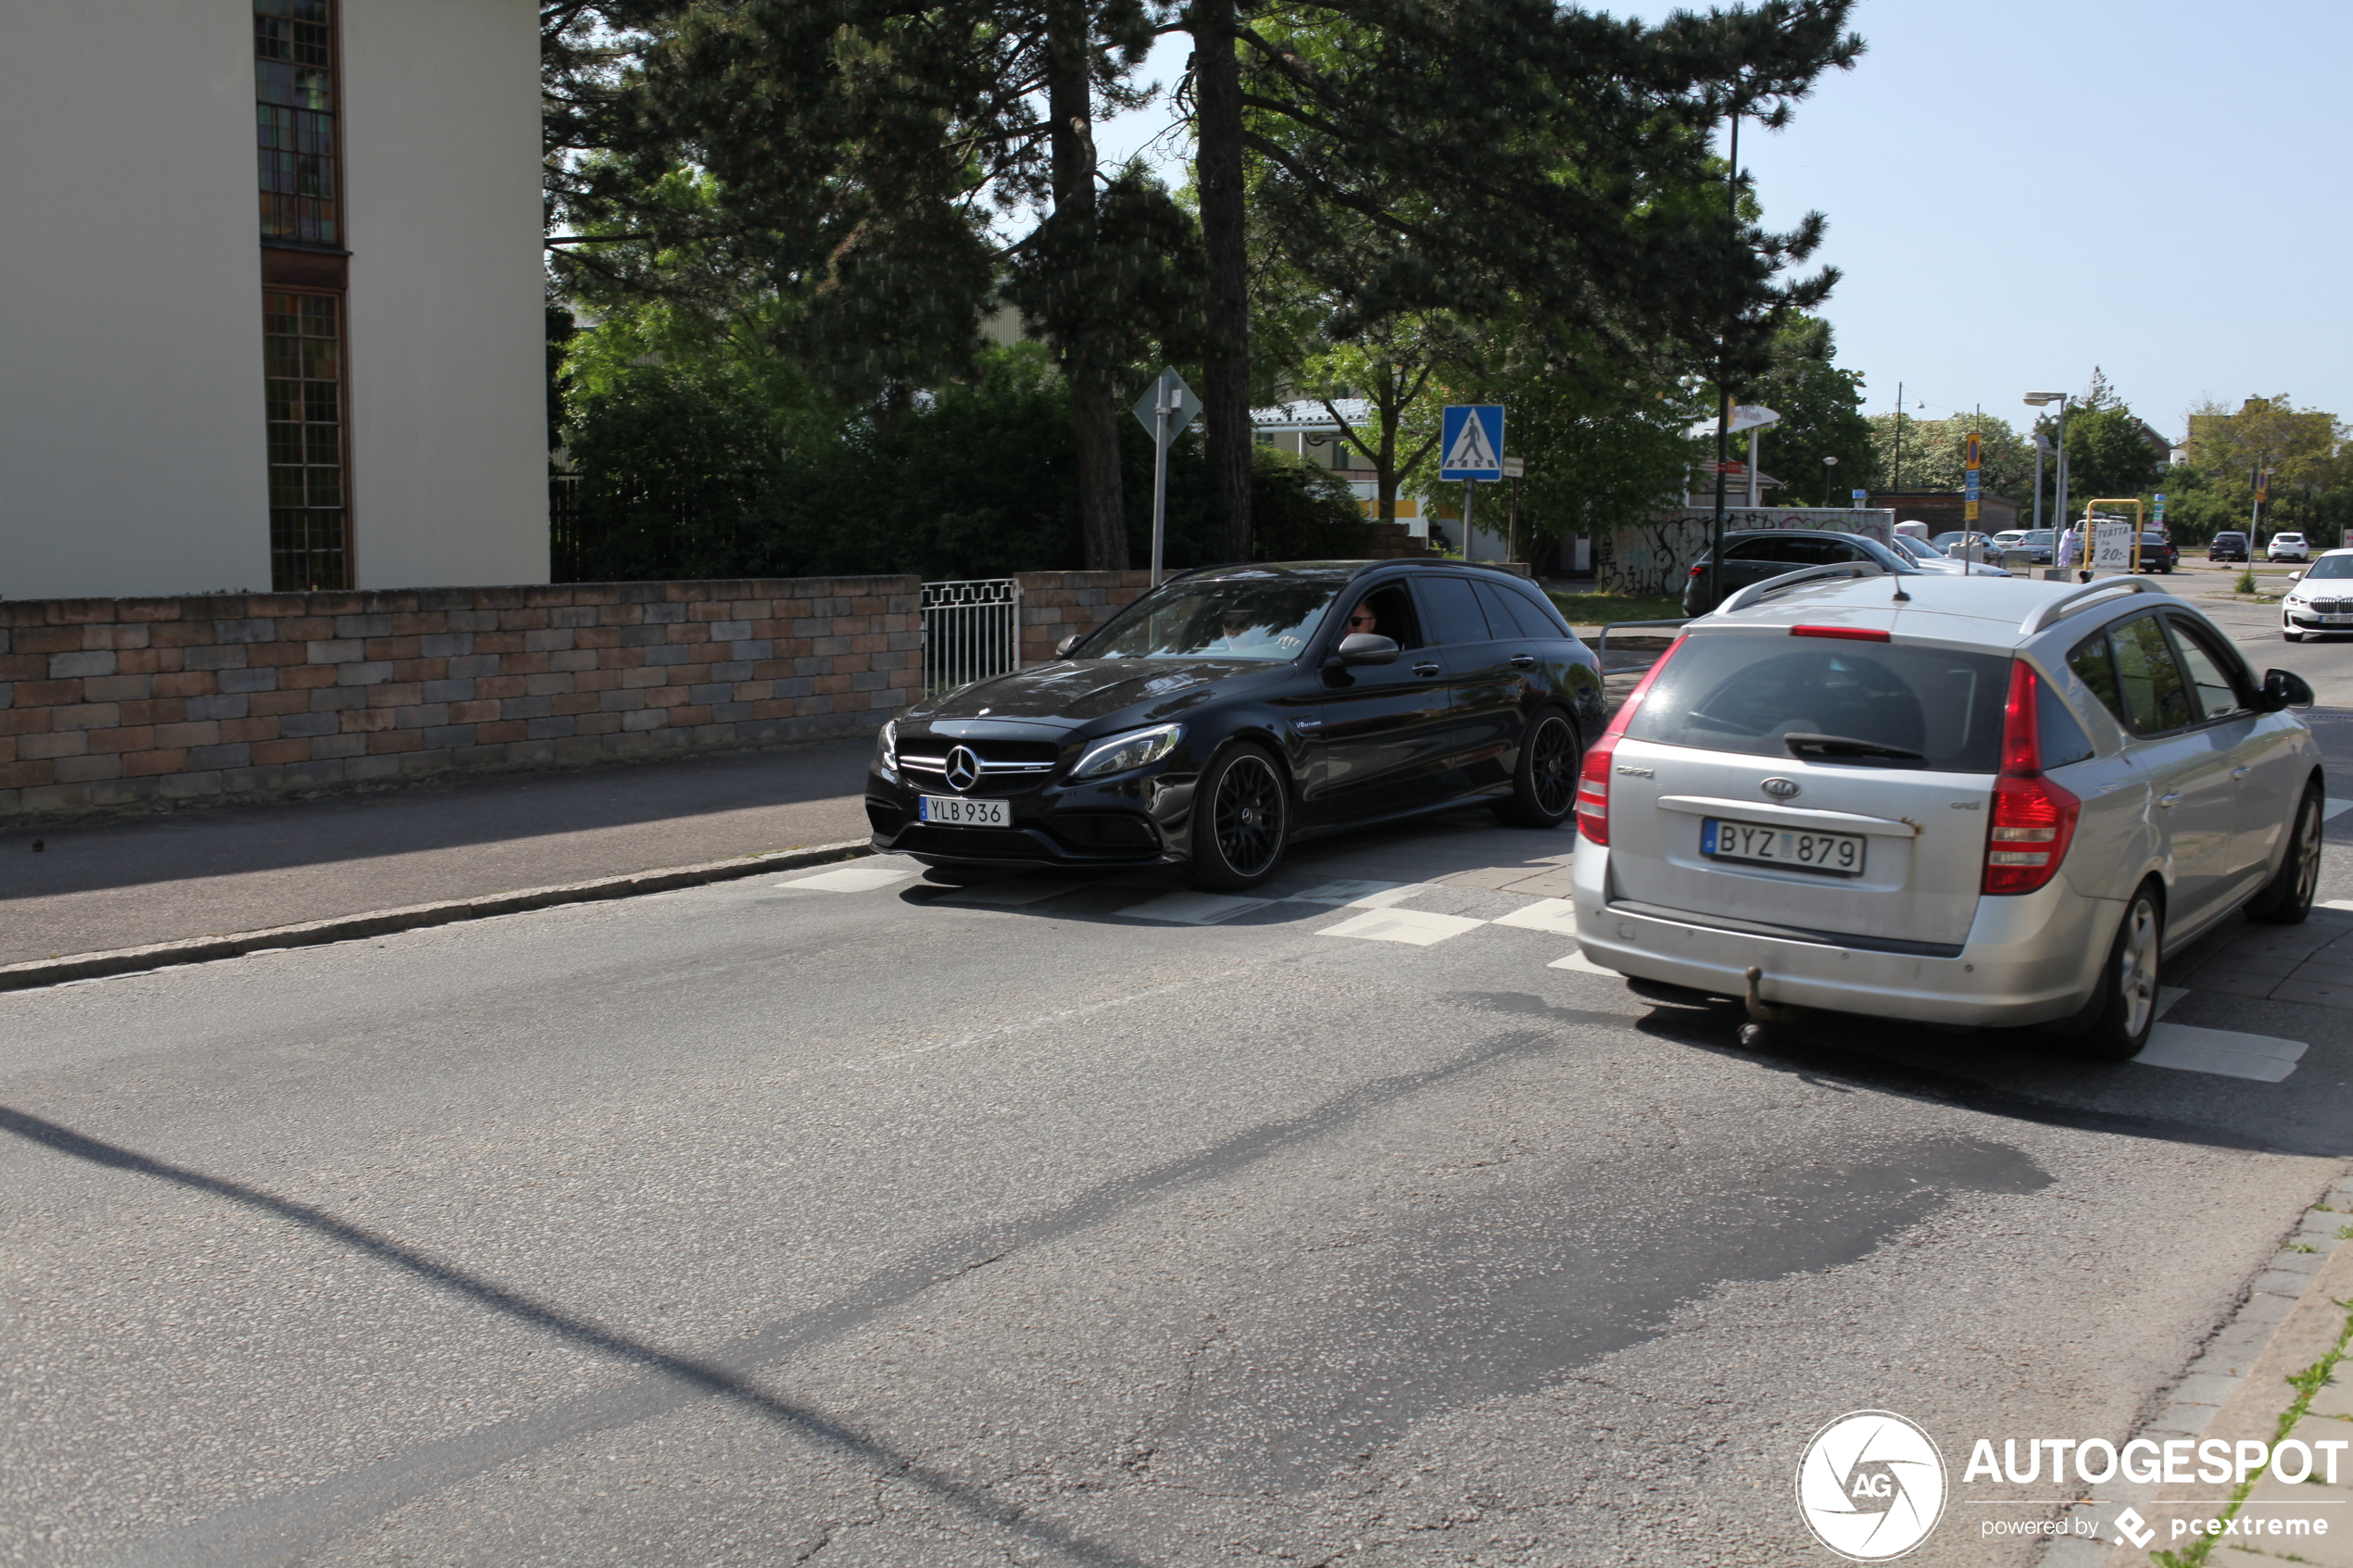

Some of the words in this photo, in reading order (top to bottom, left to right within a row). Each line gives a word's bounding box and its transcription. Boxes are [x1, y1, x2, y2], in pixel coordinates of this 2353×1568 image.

[2098, 526, 2129, 538] TVÄTTA
[2100, 547, 2127, 560] 20:-
[1765, 779, 1796, 796] KIA
[931, 800, 960, 821] YLB
[965, 803, 1000, 822] 936
[1720, 825, 1775, 858] BYZ
[1797, 835, 1856, 867] 879
